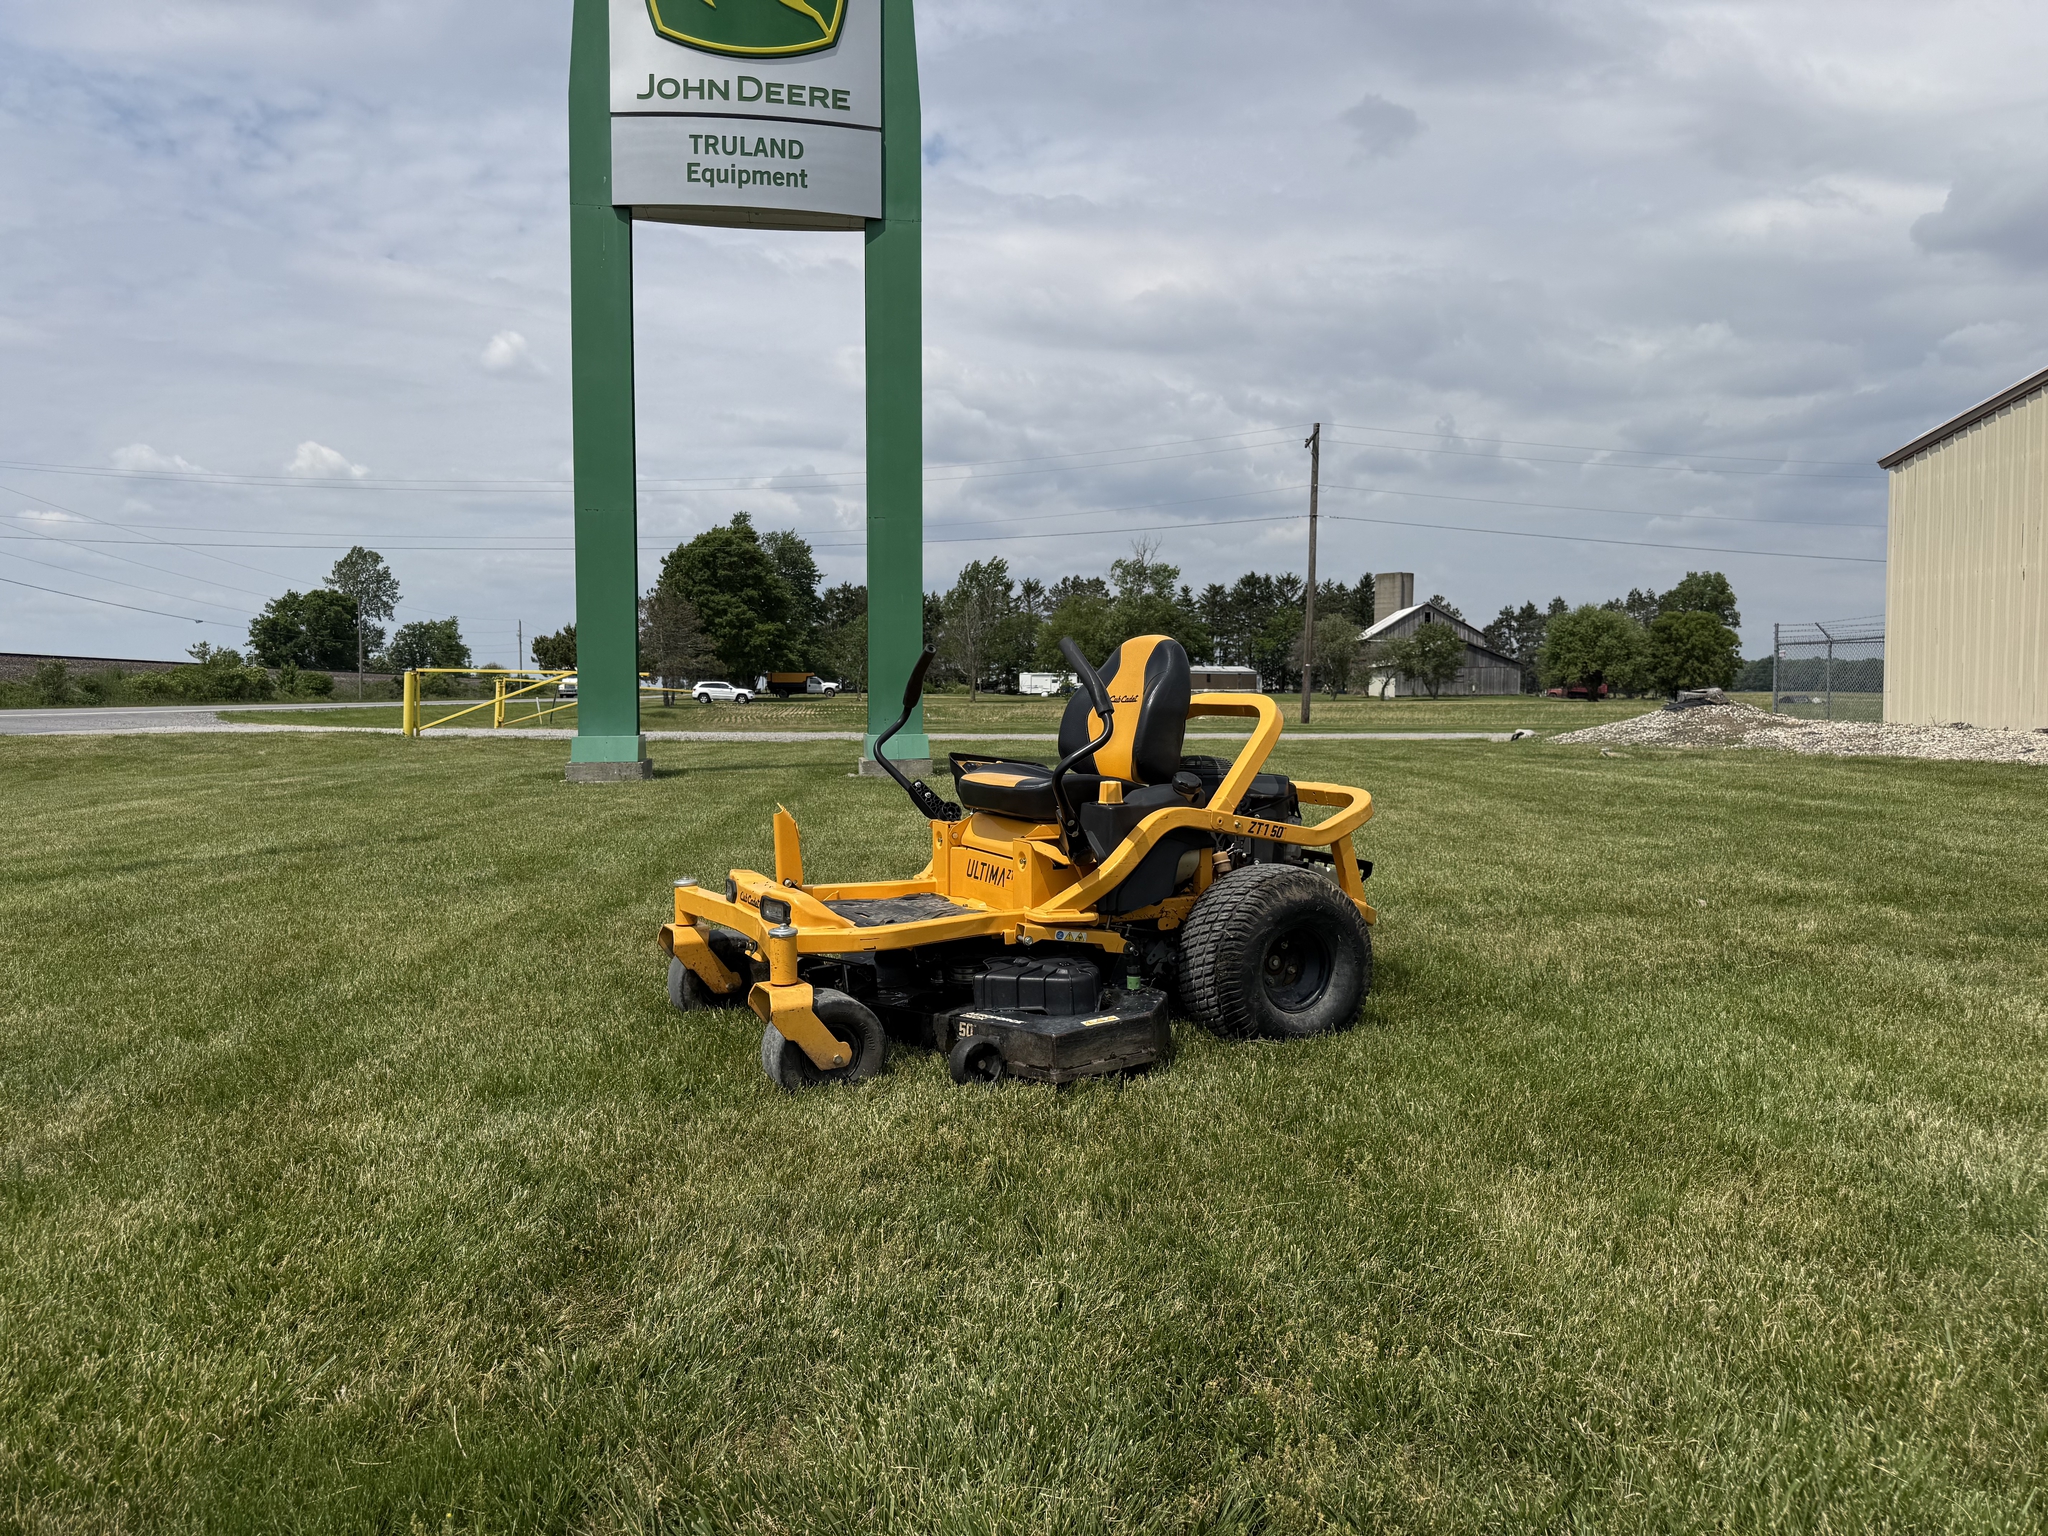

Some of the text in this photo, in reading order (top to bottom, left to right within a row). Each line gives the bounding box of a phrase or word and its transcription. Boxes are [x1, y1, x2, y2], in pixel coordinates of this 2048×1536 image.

[636, 73, 851, 111] JOHN DEERE
[688, 134, 805, 160] TRULAND
[686, 162, 808, 189] Equipment
[1247, 821, 1270, 836] ZT1
[966, 858, 1006, 888] ULTIMA
